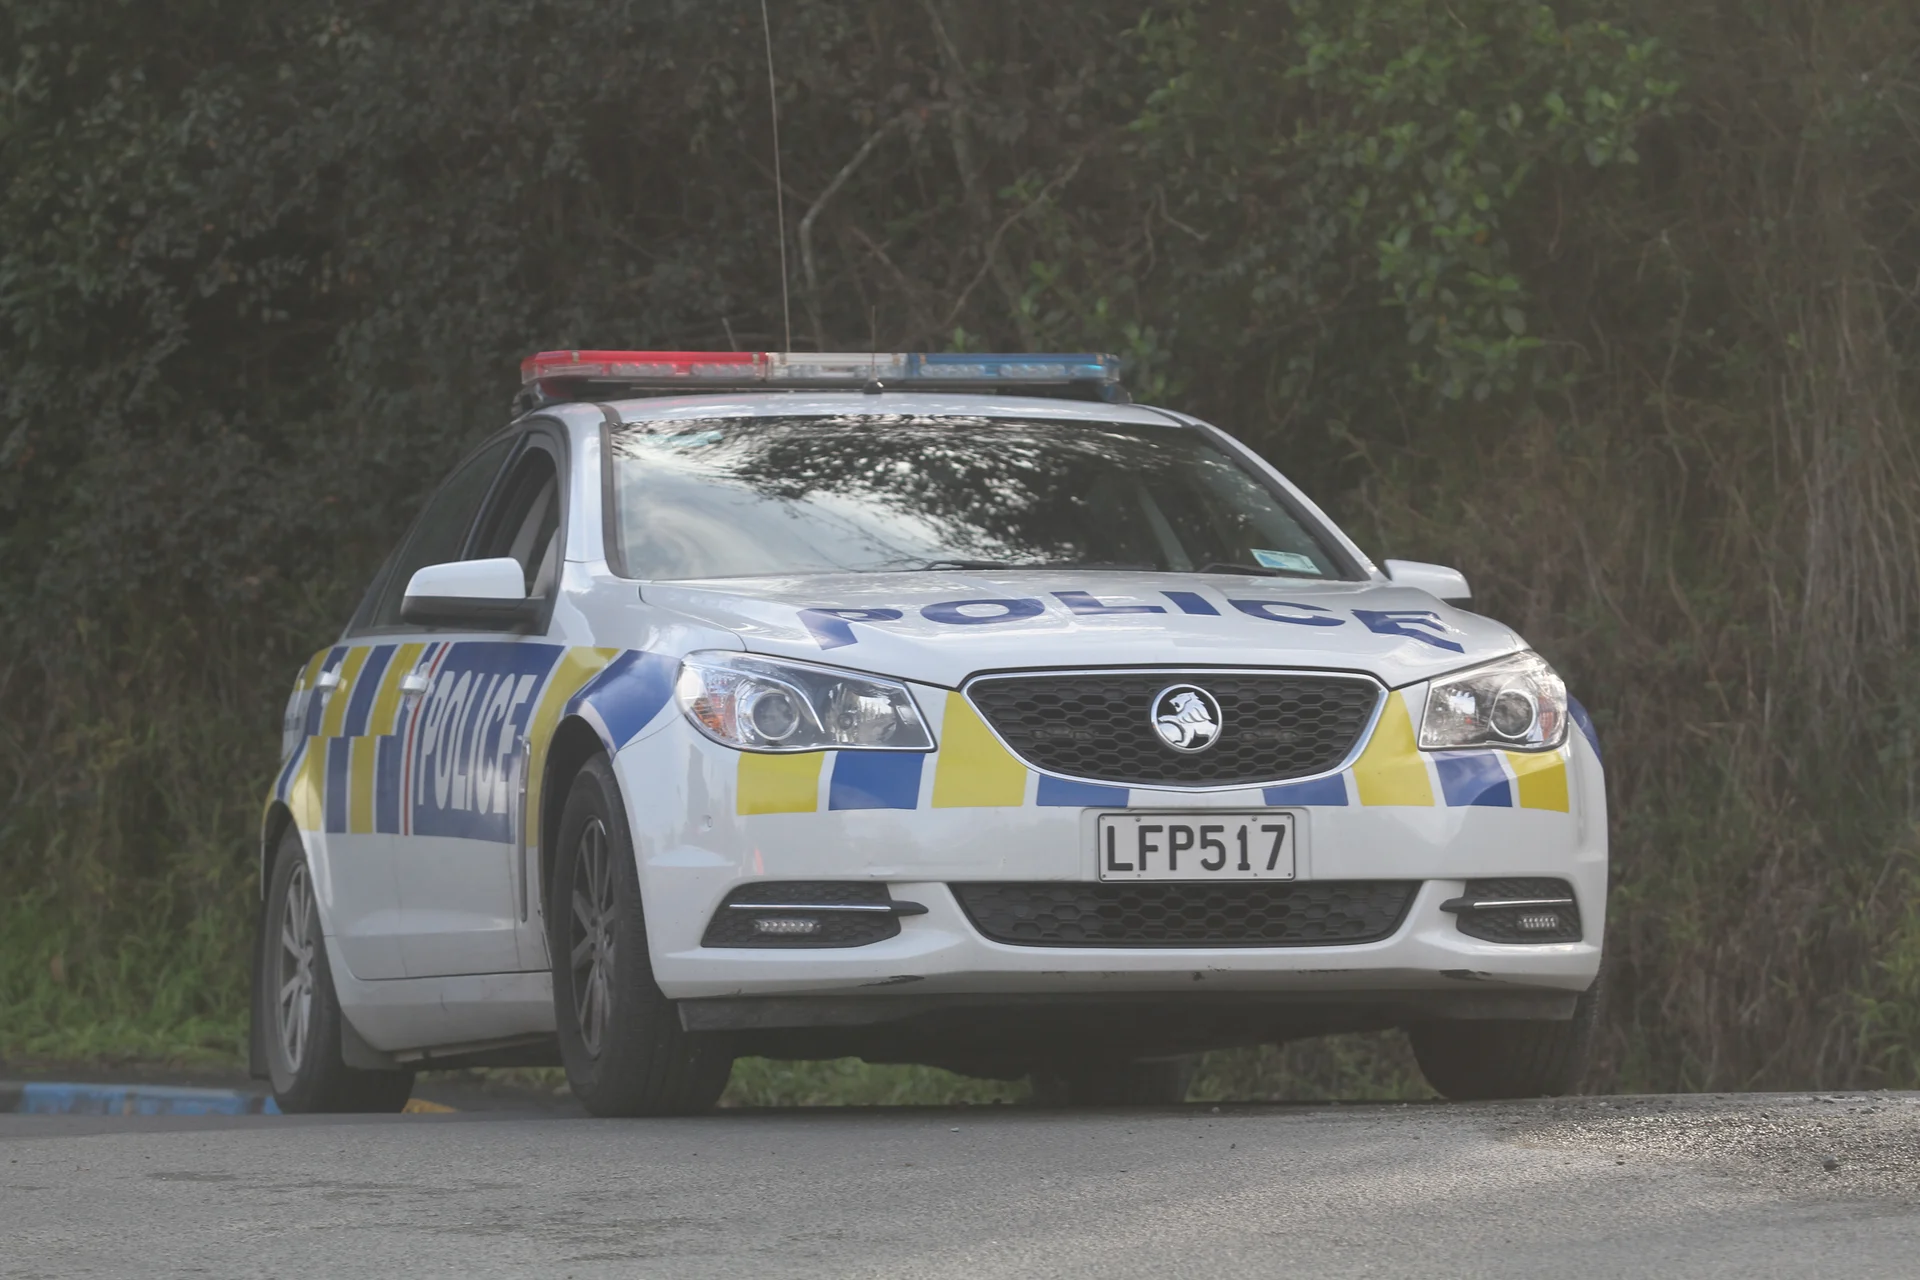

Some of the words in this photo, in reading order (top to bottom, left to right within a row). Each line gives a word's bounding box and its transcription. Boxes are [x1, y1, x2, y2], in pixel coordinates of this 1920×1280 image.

[797, 591, 1465, 654] POLICE
[418, 670, 538, 814] POLICE
[1107, 824, 1286, 871] LFP517
